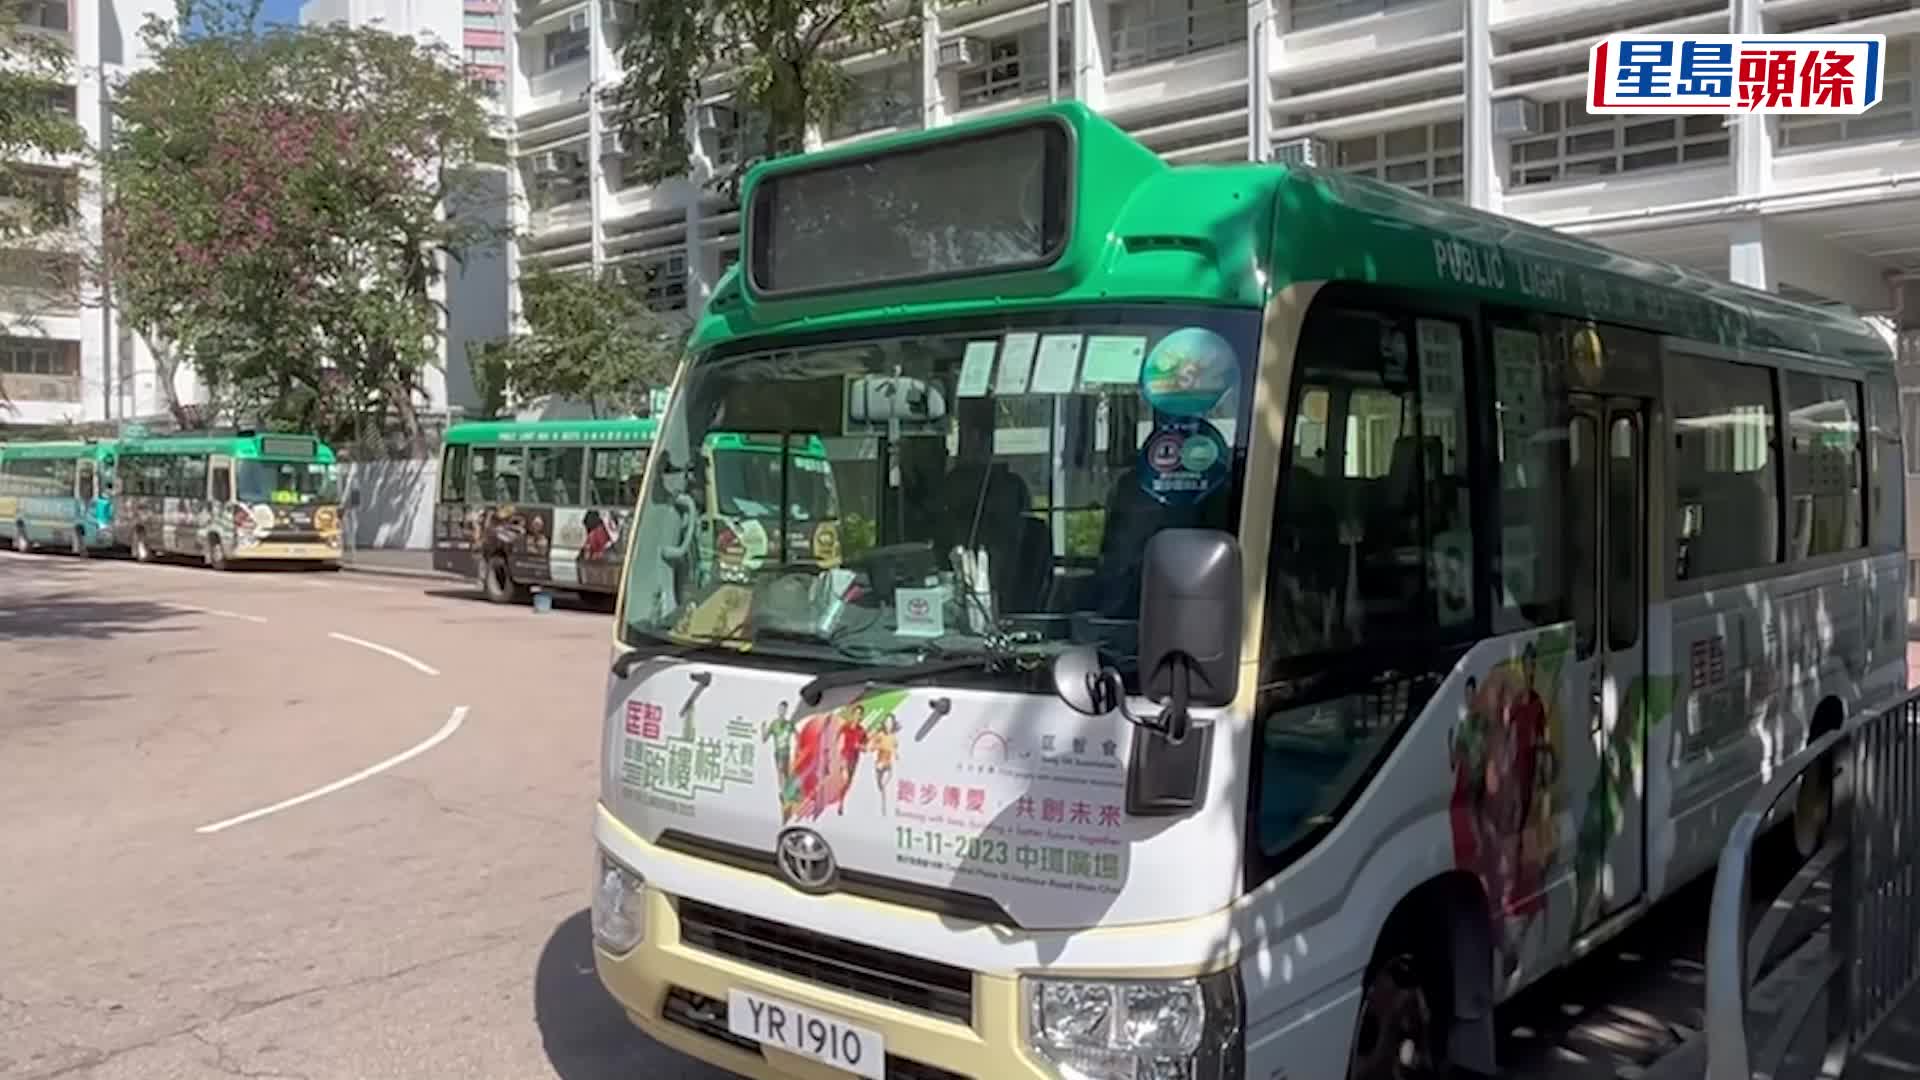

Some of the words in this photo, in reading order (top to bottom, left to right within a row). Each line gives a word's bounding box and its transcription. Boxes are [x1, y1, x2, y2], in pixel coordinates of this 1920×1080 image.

[1432, 238, 1505, 289] PUBLIC
[1517, 257, 1567, 301] LIGHT
[896, 826, 1009, 866] 11-11-2023
[748, 998, 785, 1042] YR
[797, 1014, 861, 1065] 1910
